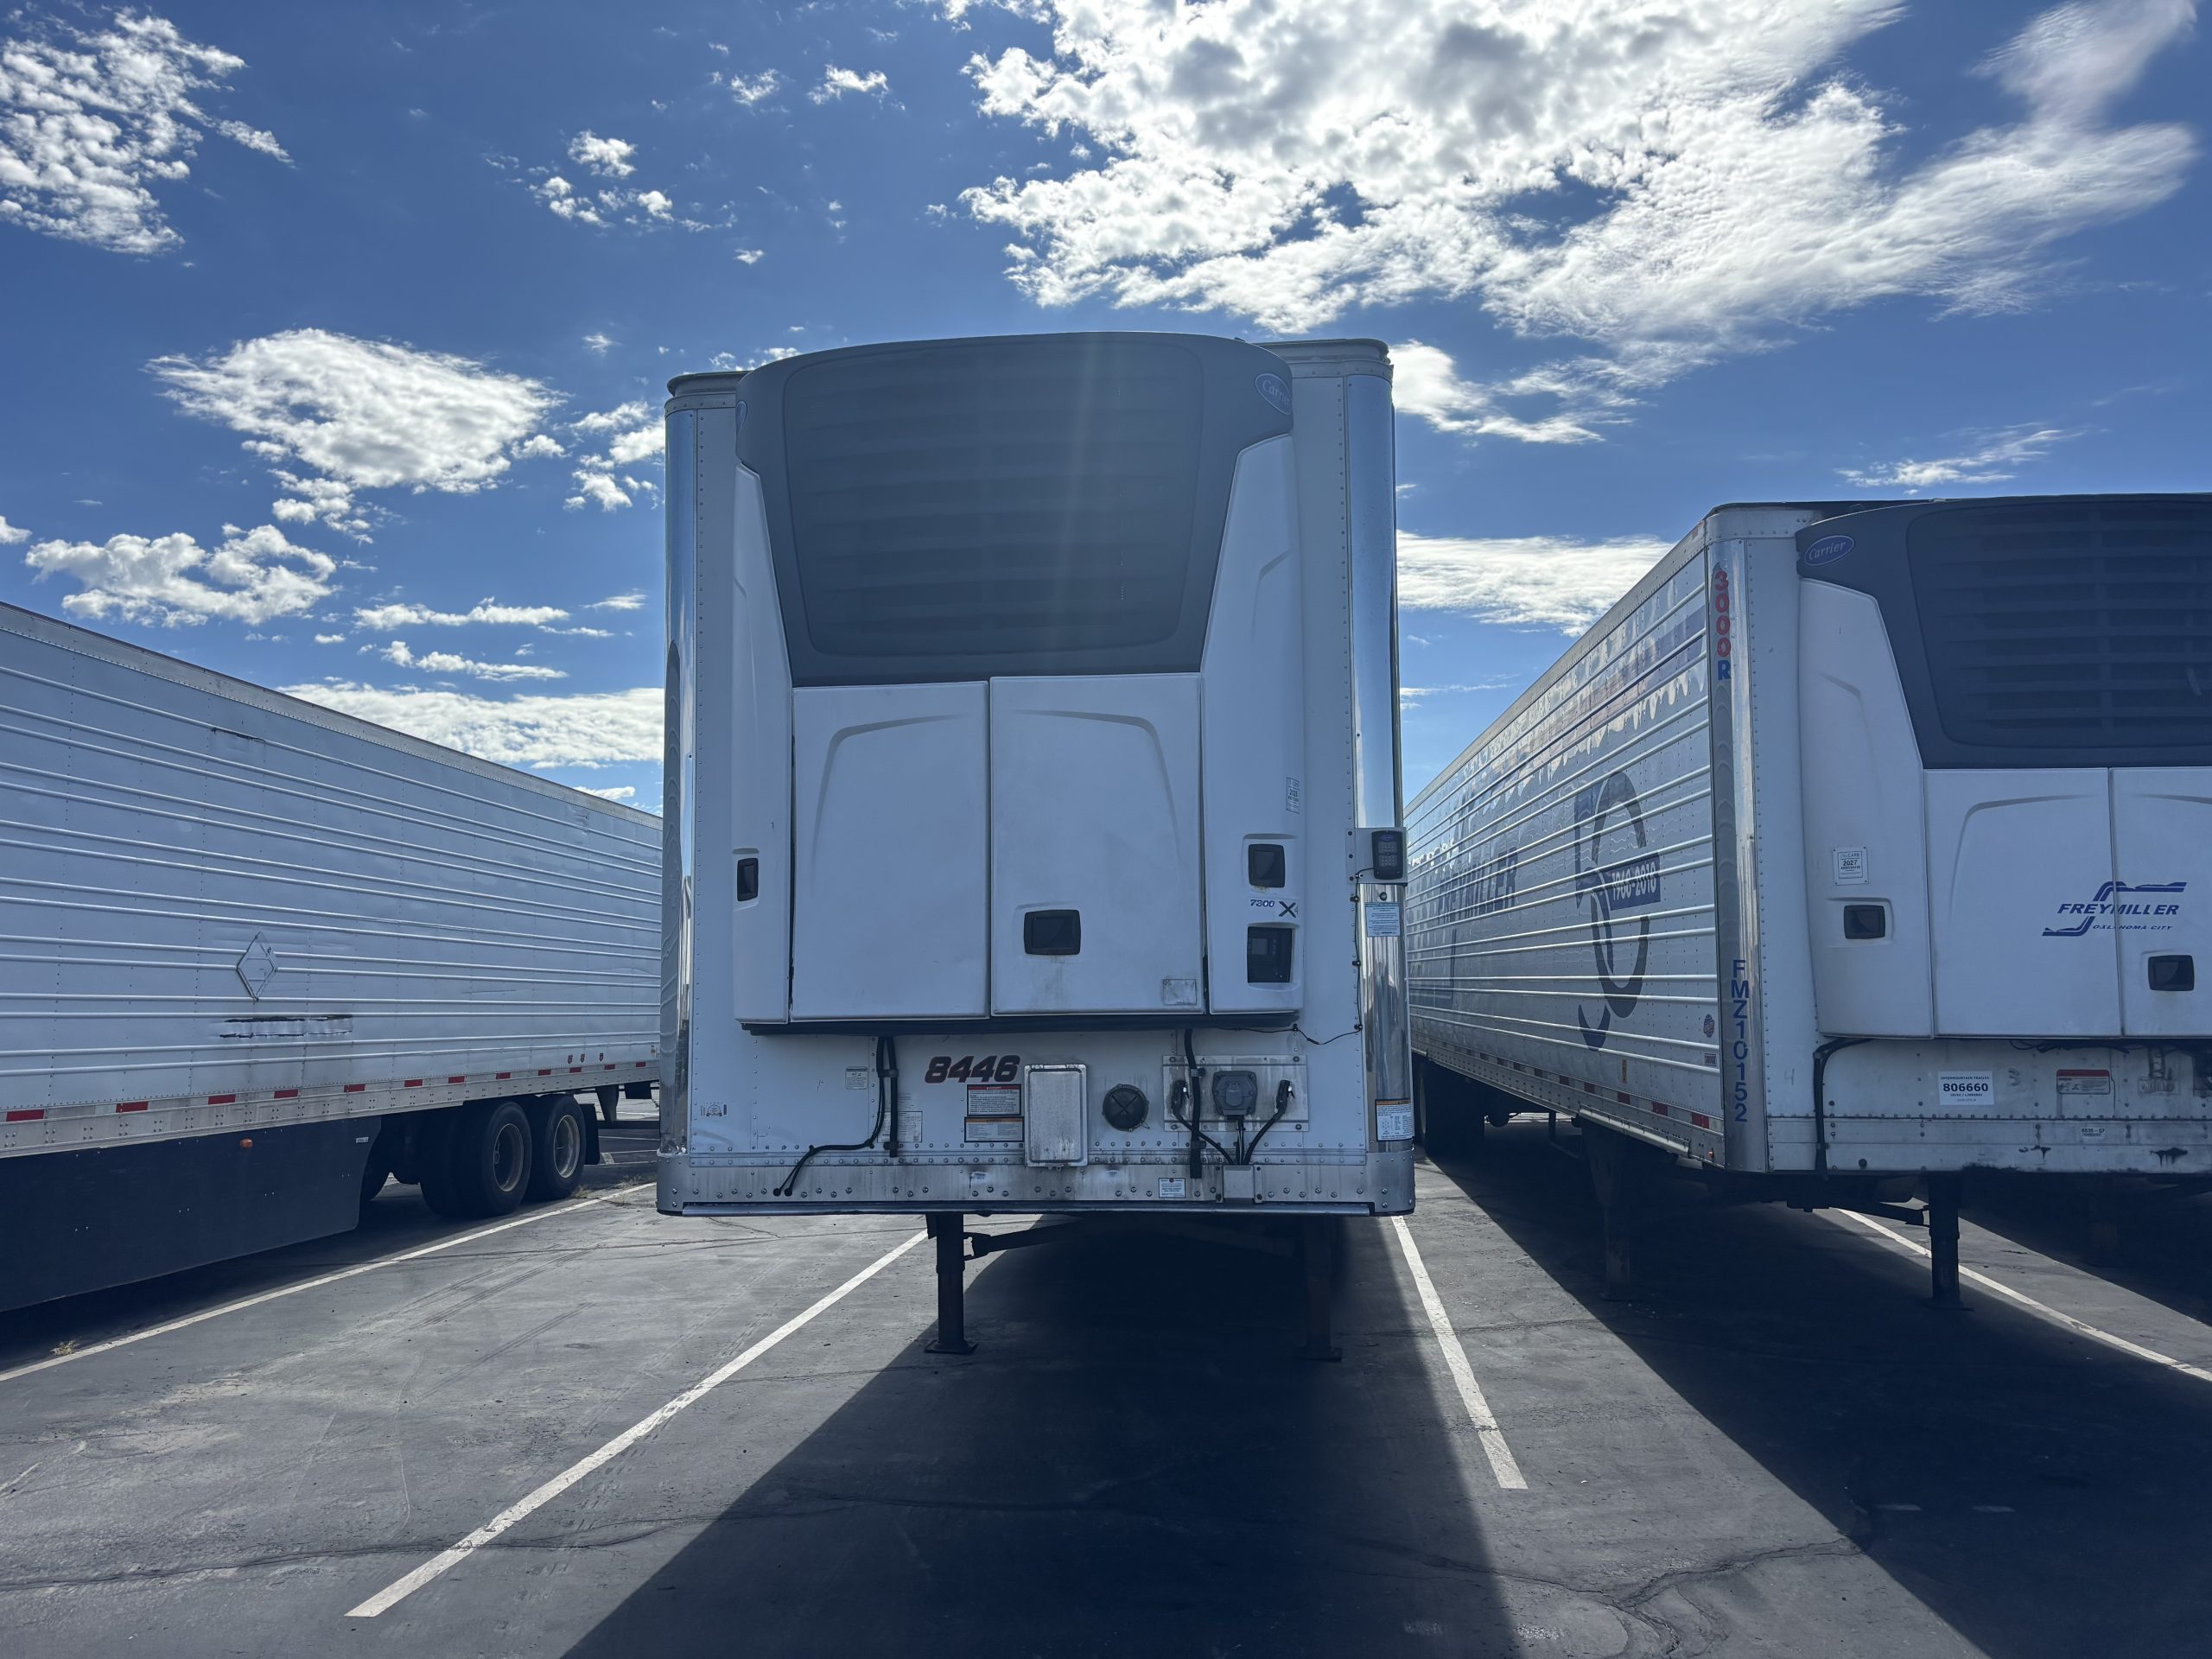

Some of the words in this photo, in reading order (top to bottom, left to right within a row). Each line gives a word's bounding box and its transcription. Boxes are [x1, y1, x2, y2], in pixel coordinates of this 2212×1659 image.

[1809, 541, 1847, 560] Carrier
[1714, 570, 1732, 680] 3000R
[2057, 903, 2180, 915] FREYMILLER
[1731, 959, 1750, 1122] FMZ10152
[925, 1055, 1020, 1084] 8446
[1942, 1083, 1989, 1092] 806660
